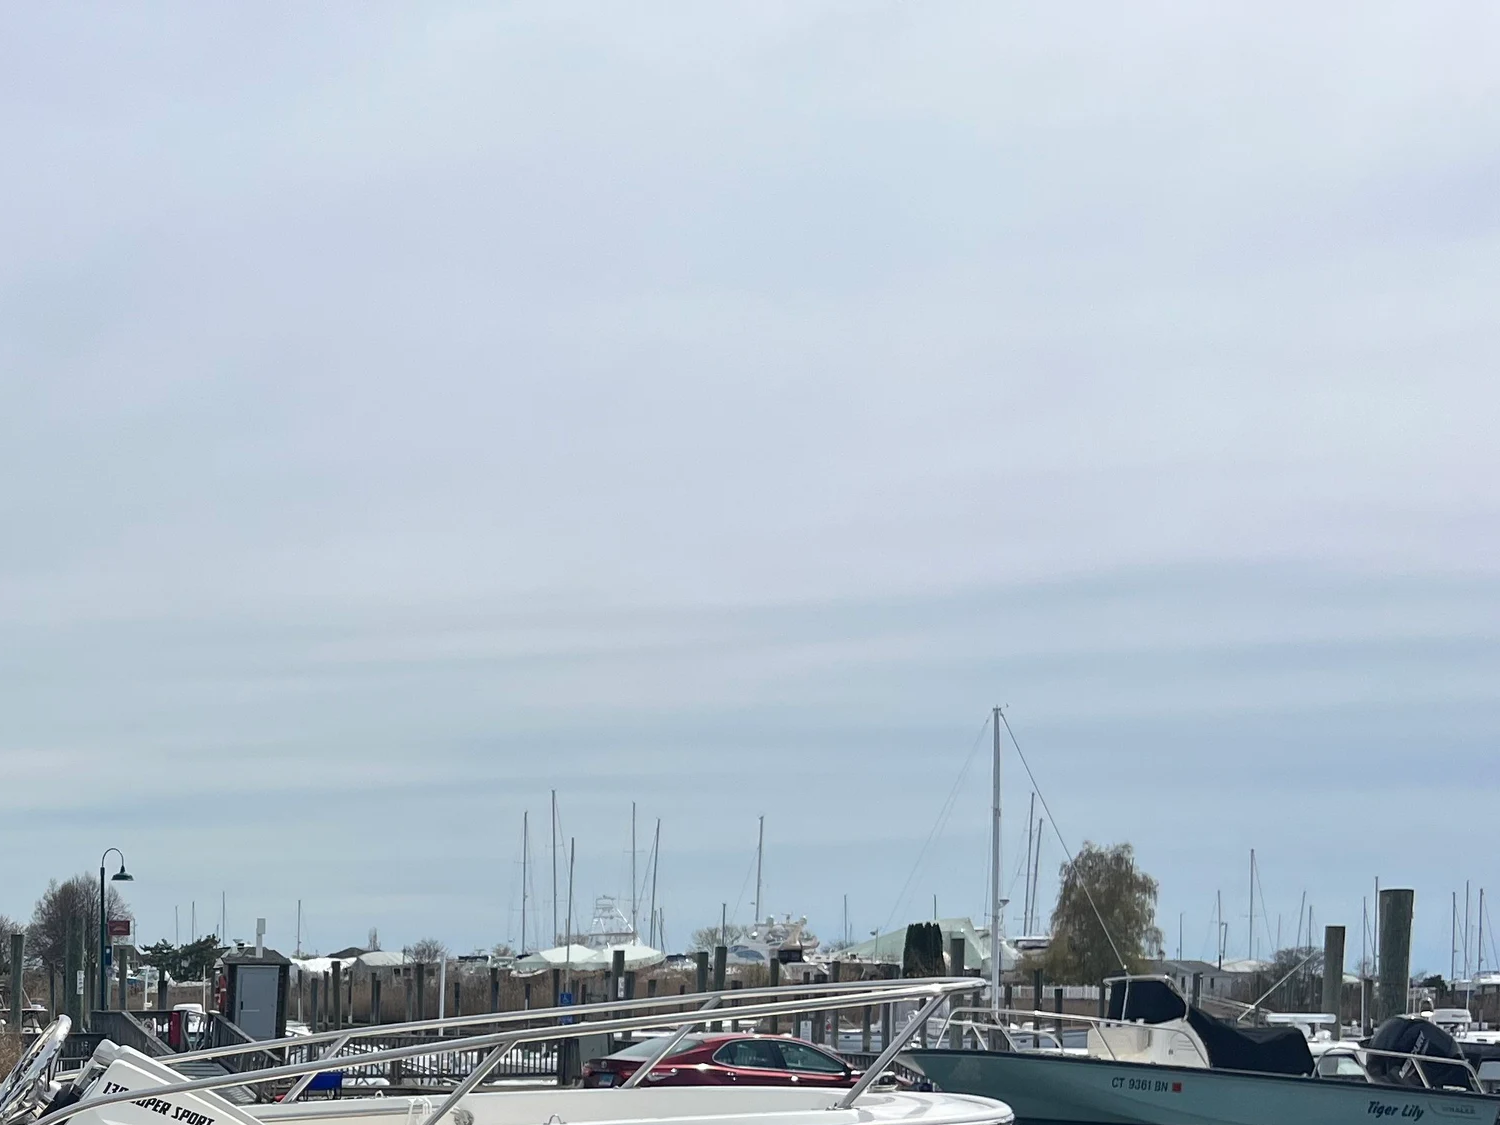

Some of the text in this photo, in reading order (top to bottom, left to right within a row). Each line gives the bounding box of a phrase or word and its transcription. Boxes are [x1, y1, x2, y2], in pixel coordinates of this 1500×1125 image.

[1111, 1077, 1125, 1088] CT
[1128, 1078, 1151, 1091] 9361
[1154, 1080, 1168, 1092] BN
[130, 1098, 172, 1116] UPER
[1367, 1101, 1424, 1121] Tiger Lily
